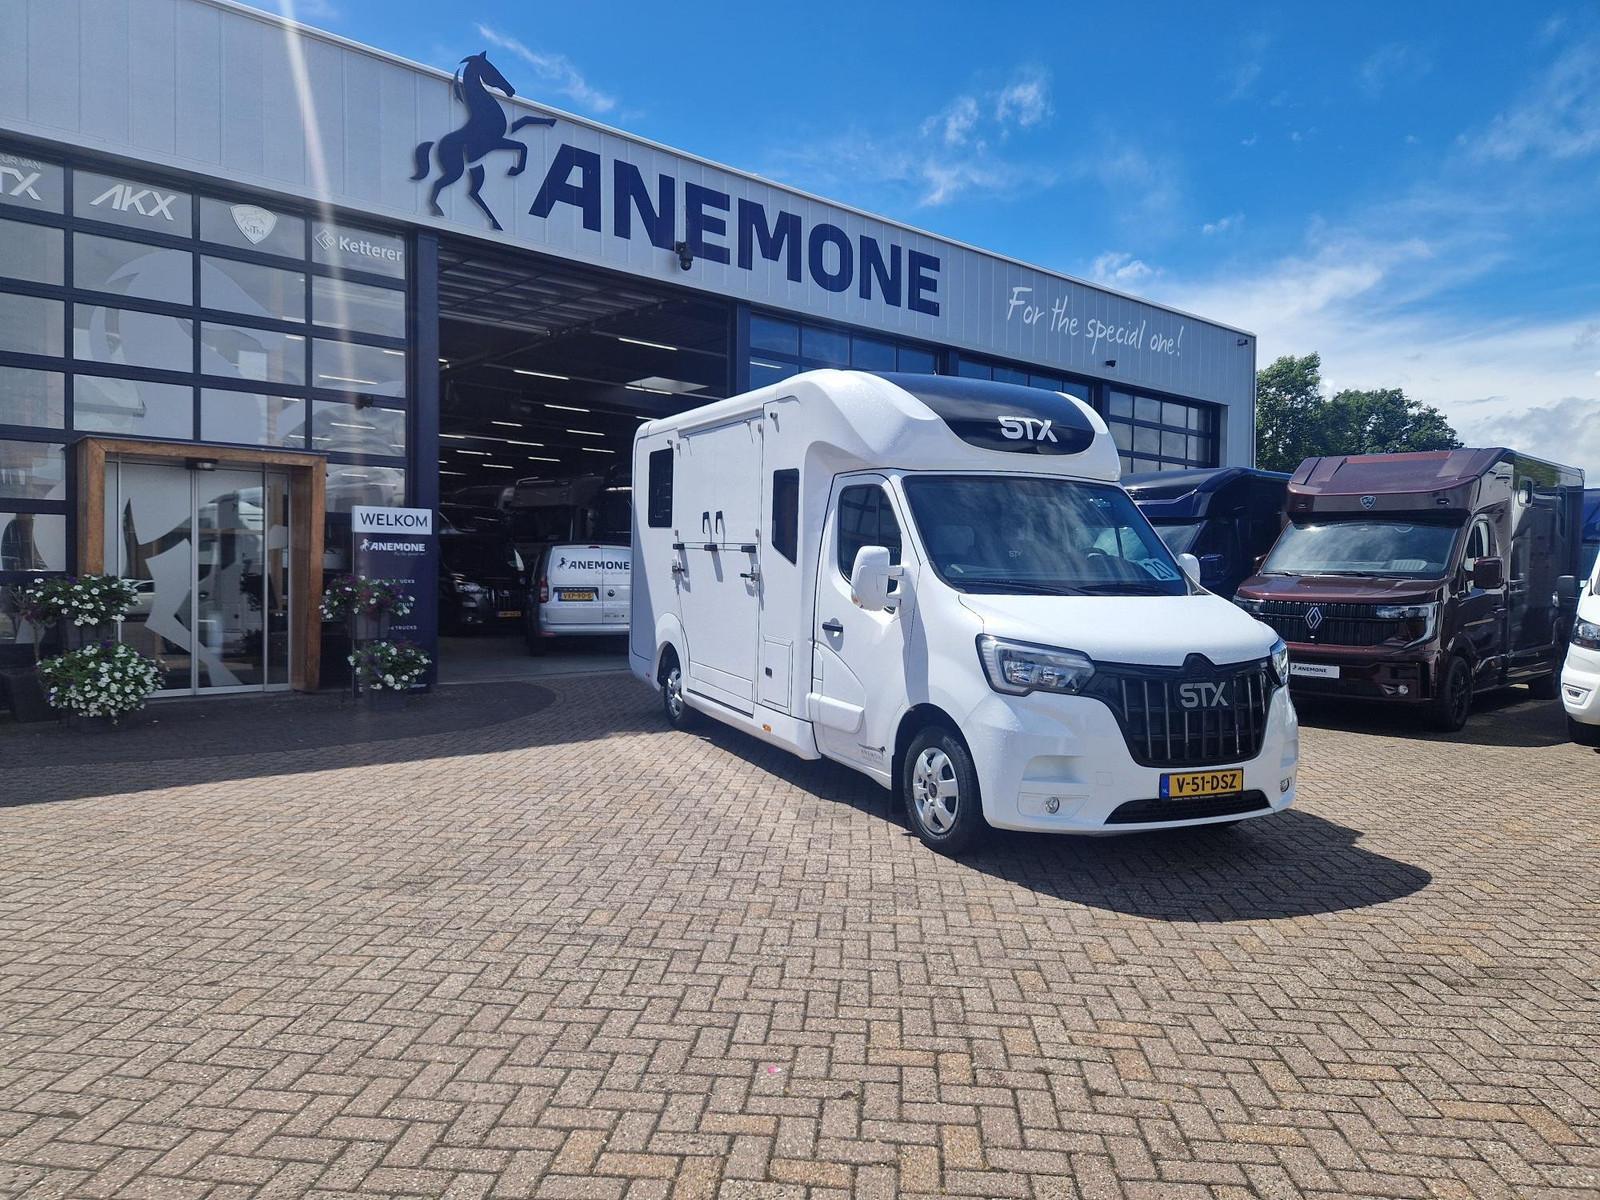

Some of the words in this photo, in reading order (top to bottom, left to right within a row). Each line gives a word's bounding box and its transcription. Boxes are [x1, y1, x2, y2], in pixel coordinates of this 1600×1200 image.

[89, 184, 177, 221] AKX
[529, 144, 940, 316] ANEMONE
[339, 236, 402, 261] Ketterer
[1008, 287, 1045, 325] For
[1051, 296, 1080, 336] the
[1086, 319, 1146, 355] special
[1150, 326, 1184, 357] one!
[998, 415, 1058, 443] STX
[360, 512, 428, 527] WELKOM
[370, 542, 426, 552] ANEMONE
[569, 560, 631, 570] ANEMONE
[1297, 665, 1327, 673] ANEMONE
[1180, 682, 1229, 708] STX
[1176, 773, 1237, 793] V-51-DSZ
